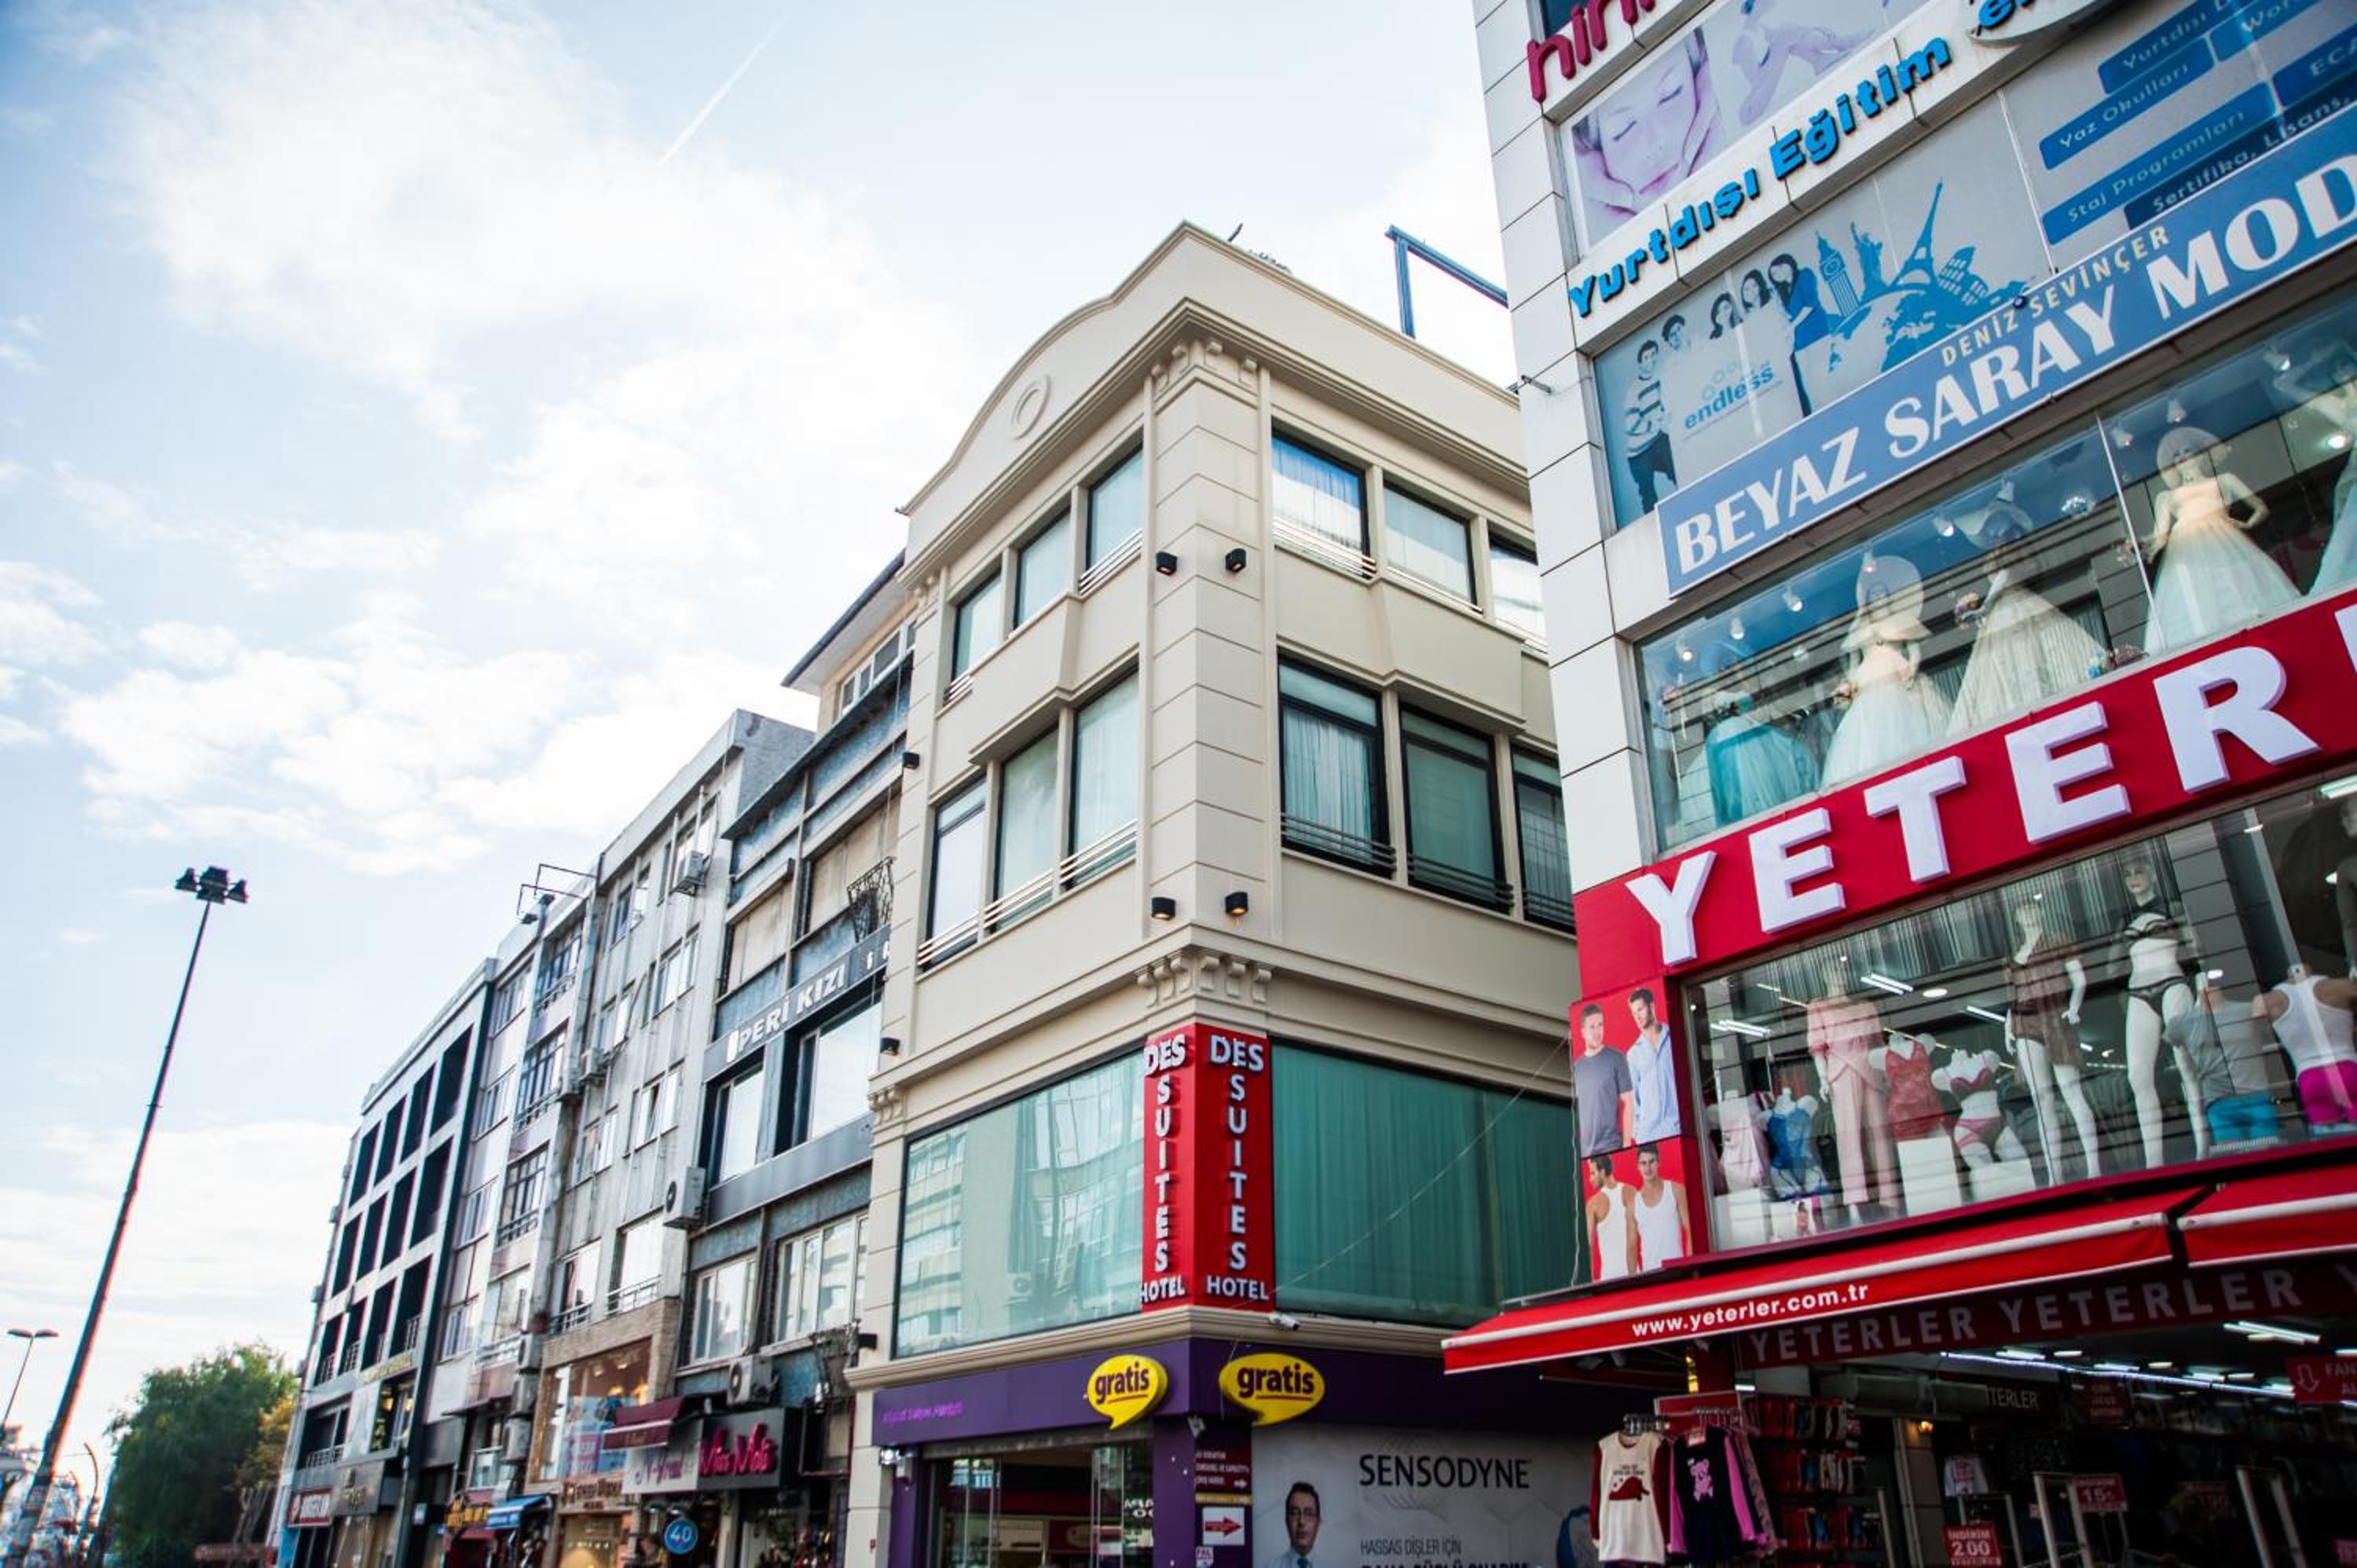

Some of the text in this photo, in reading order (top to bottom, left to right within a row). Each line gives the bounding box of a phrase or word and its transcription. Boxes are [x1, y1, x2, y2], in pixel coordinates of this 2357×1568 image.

[2058, 122, 2098, 148] Yaz
[1568, 36, 1953, 317] Yurtdışı Eğitim
[2068, 111, 2245, 222] Staj Programları
[1941, 225, 2171, 368] DENİZ SEVİNÇER
[1675, 427, 1867, 576] BEYAZ
[1885, 284, 2116, 460] SARAY
[1625, 603, 2357, 967] YETER
[796, 964, 846, 1014] KIZI
[1144, 1034, 1186, 1077] DES
[1210, 1035, 1264, 1072] DES
[1141, 1275, 1186, 1304] HOTEL
[1206, 1274, 1270, 1301] HOTEL
[1632, 1284, 1869, 1337] www.yeterler.com.tr
[1750, 1305, 1978, 1364] YETERLER
[1999, 1269, 2304, 1334] YETERLER
[1094, 1362, 1150, 1405] gratis
[1237, 1363, 1314, 1398] gratis
[1359, 1454, 1530, 1488] SENSODYNE
